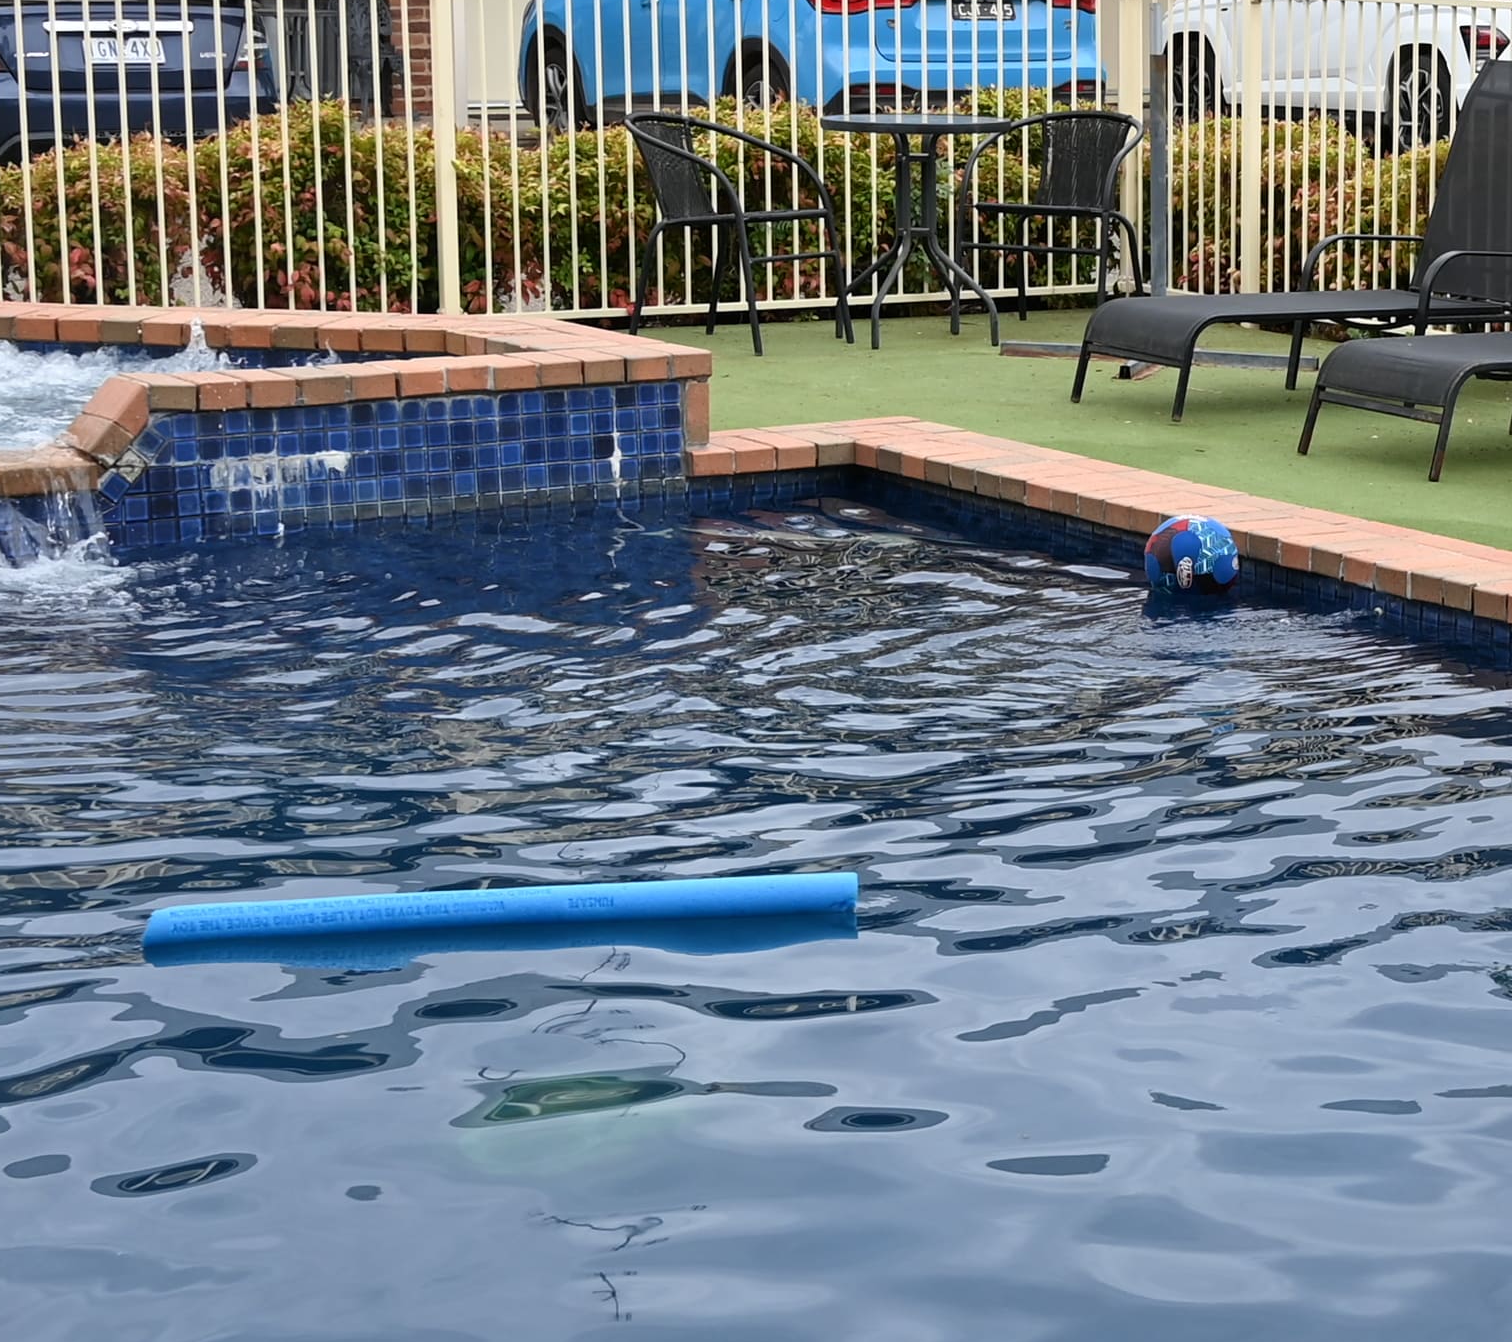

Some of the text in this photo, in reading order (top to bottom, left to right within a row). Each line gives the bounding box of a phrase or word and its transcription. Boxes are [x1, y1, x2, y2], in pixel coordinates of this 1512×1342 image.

[568, 896, 615, 909] FUNSAFE
[399, 906, 422, 917] TOY
[170, 921, 196, 934] TOY
[199, 920, 219, 932] THE
